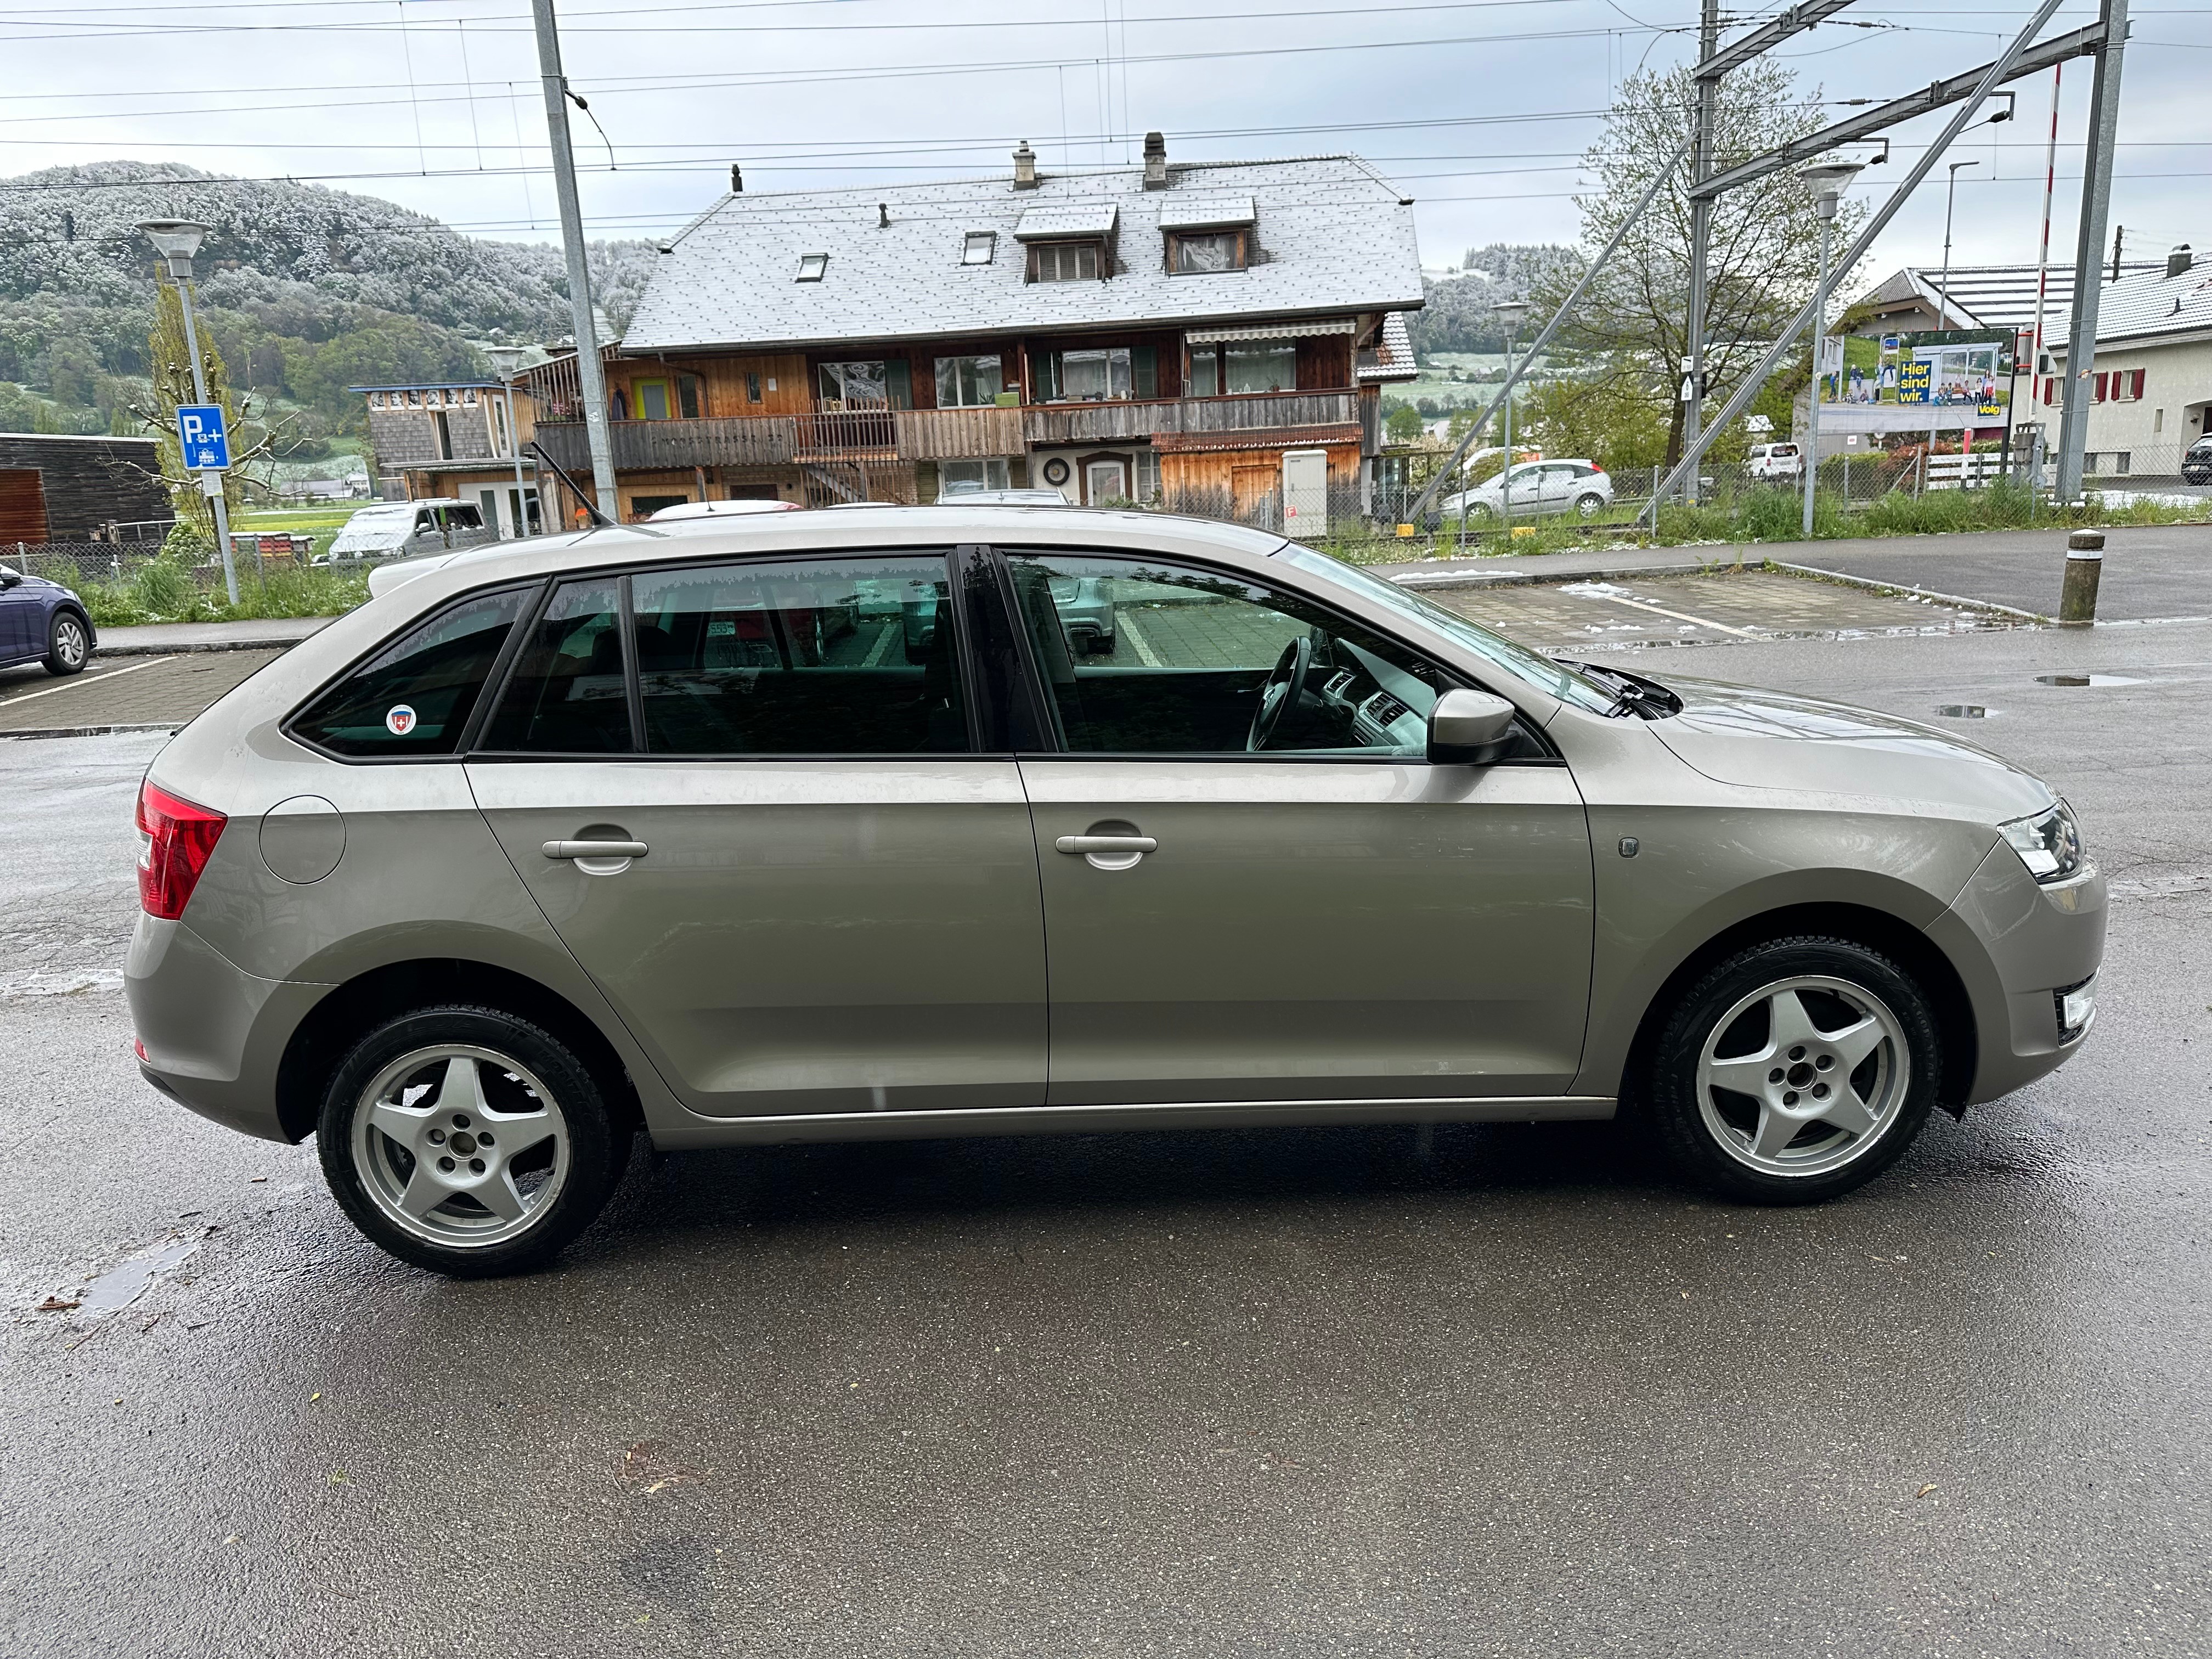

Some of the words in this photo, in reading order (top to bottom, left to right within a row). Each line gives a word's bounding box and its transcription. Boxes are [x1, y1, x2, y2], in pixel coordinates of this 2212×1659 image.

[1901, 362, 1929, 375] Hier
[1900, 375, 1929, 389] sind
[1900, 388, 1923, 402] wir.
[1978, 405, 2000, 415] Volg
[183, 415, 203, 443] P
[1287, 507, 1294, 517] F
